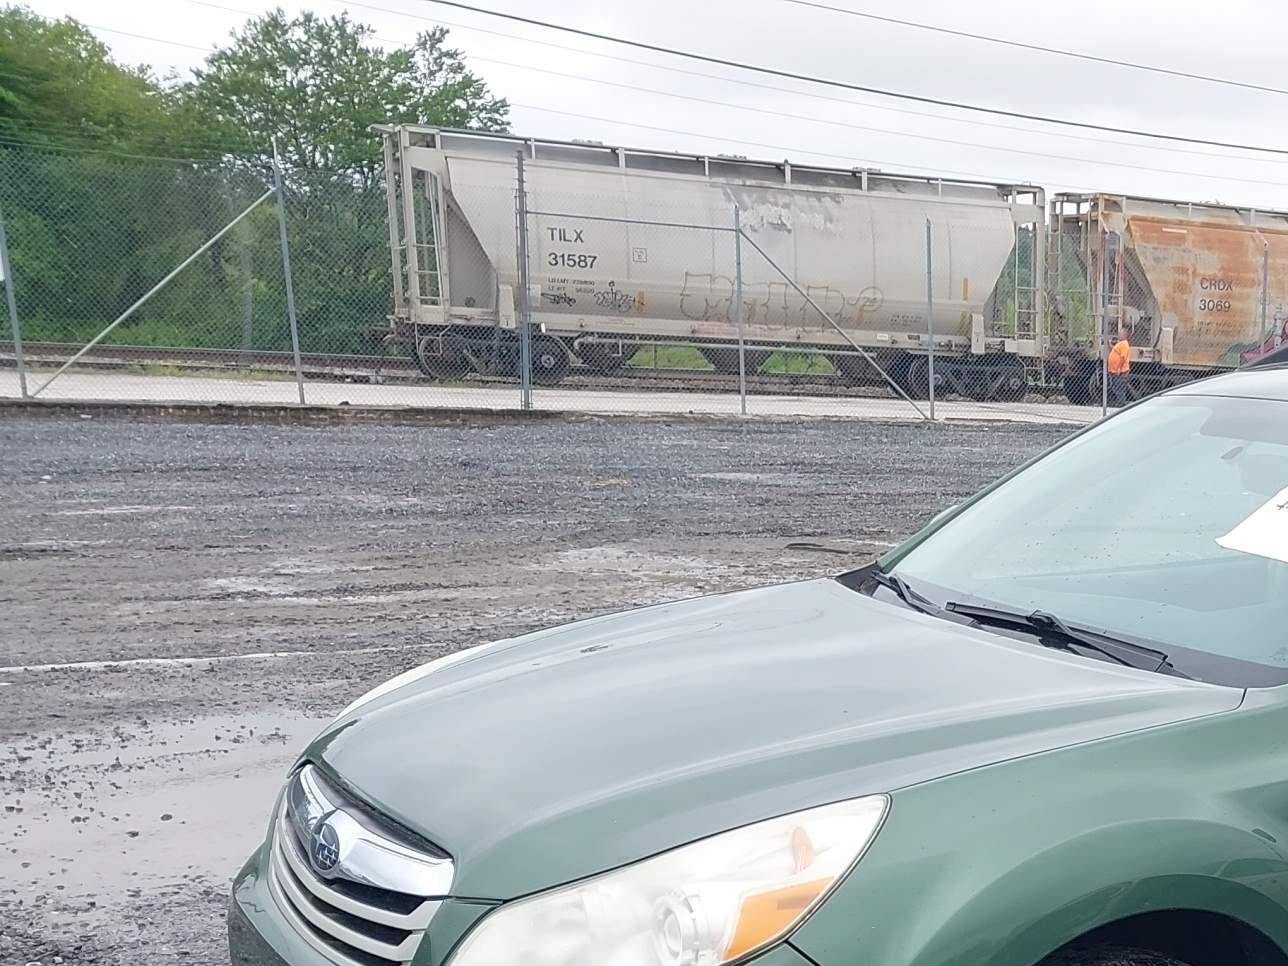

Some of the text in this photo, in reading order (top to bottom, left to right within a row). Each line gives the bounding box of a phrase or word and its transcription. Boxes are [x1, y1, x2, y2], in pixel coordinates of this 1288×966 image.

[547, 227, 584, 243] TILX
[548, 252, 597, 269] 31587
[1200, 277, 1233, 291] CRDX
[1199, 298, 1231, 312] 3069
